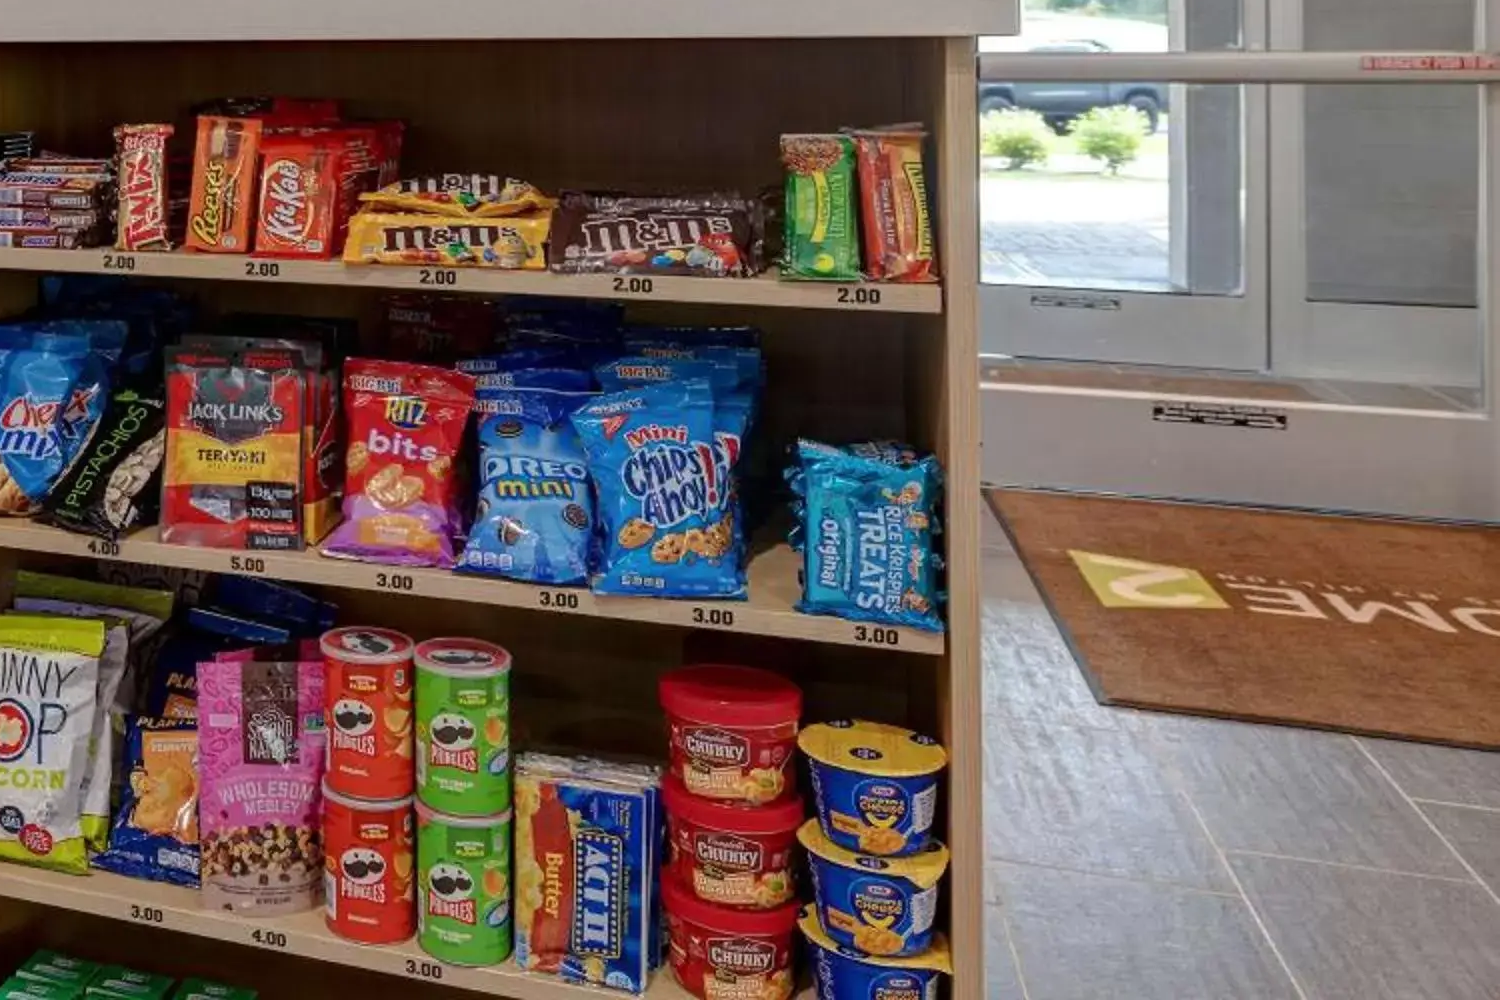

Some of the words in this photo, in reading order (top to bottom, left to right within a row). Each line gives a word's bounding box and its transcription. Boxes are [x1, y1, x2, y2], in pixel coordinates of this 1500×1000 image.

[103, 254, 135, 271] 2.00
[245, 262, 280, 277] 2.00
[419, 269, 457, 286] 2.00
[613, 277, 653, 294] 2.00
[837, 287, 881, 305] 2.00
[187, 403, 227, 426] JACK
[384, 396, 428, 425] RITZ
[367, 428, 437, 461] bits
[624, 423, 690, 449] Mini
[64, 404, 149, 508] PISTACHIOS
[197, 449, 266, 465] TERIYAKI
[484, 456, 587, 480] OREO
[622, 443, 702, 500] Chips
[496, 478, 575, 499] mini
[884, 505, 902, 543] RICE
[231, 556, 265, 573] 5.00
[856, 507, 888, 609] TREATS
[377, 573, 413, 591] 3.00
[885, 545, 904, 614] KRISPIES
[539, 591, 578, 609] 3.00
[693, 608, 733, 626] 3.00
[855, 625, 899, 645] 3.00
[686, 735, 745, 761] CHUNKY
[218, 772, 315, 805] WHOLESOM
[243, 798, 300, 816] MEDLEY
[698, 840, 758, 865] CHUNKY
[545, 851, 564, 919] Butter
[584, 844, 610, 906] ACT
[131, 905, 163, 923] 3.00
[252, 928, 287, 948] 4.00
[710, 947, 772, 967] CHUNKY
[406, 960, 443, 980] 3.00
